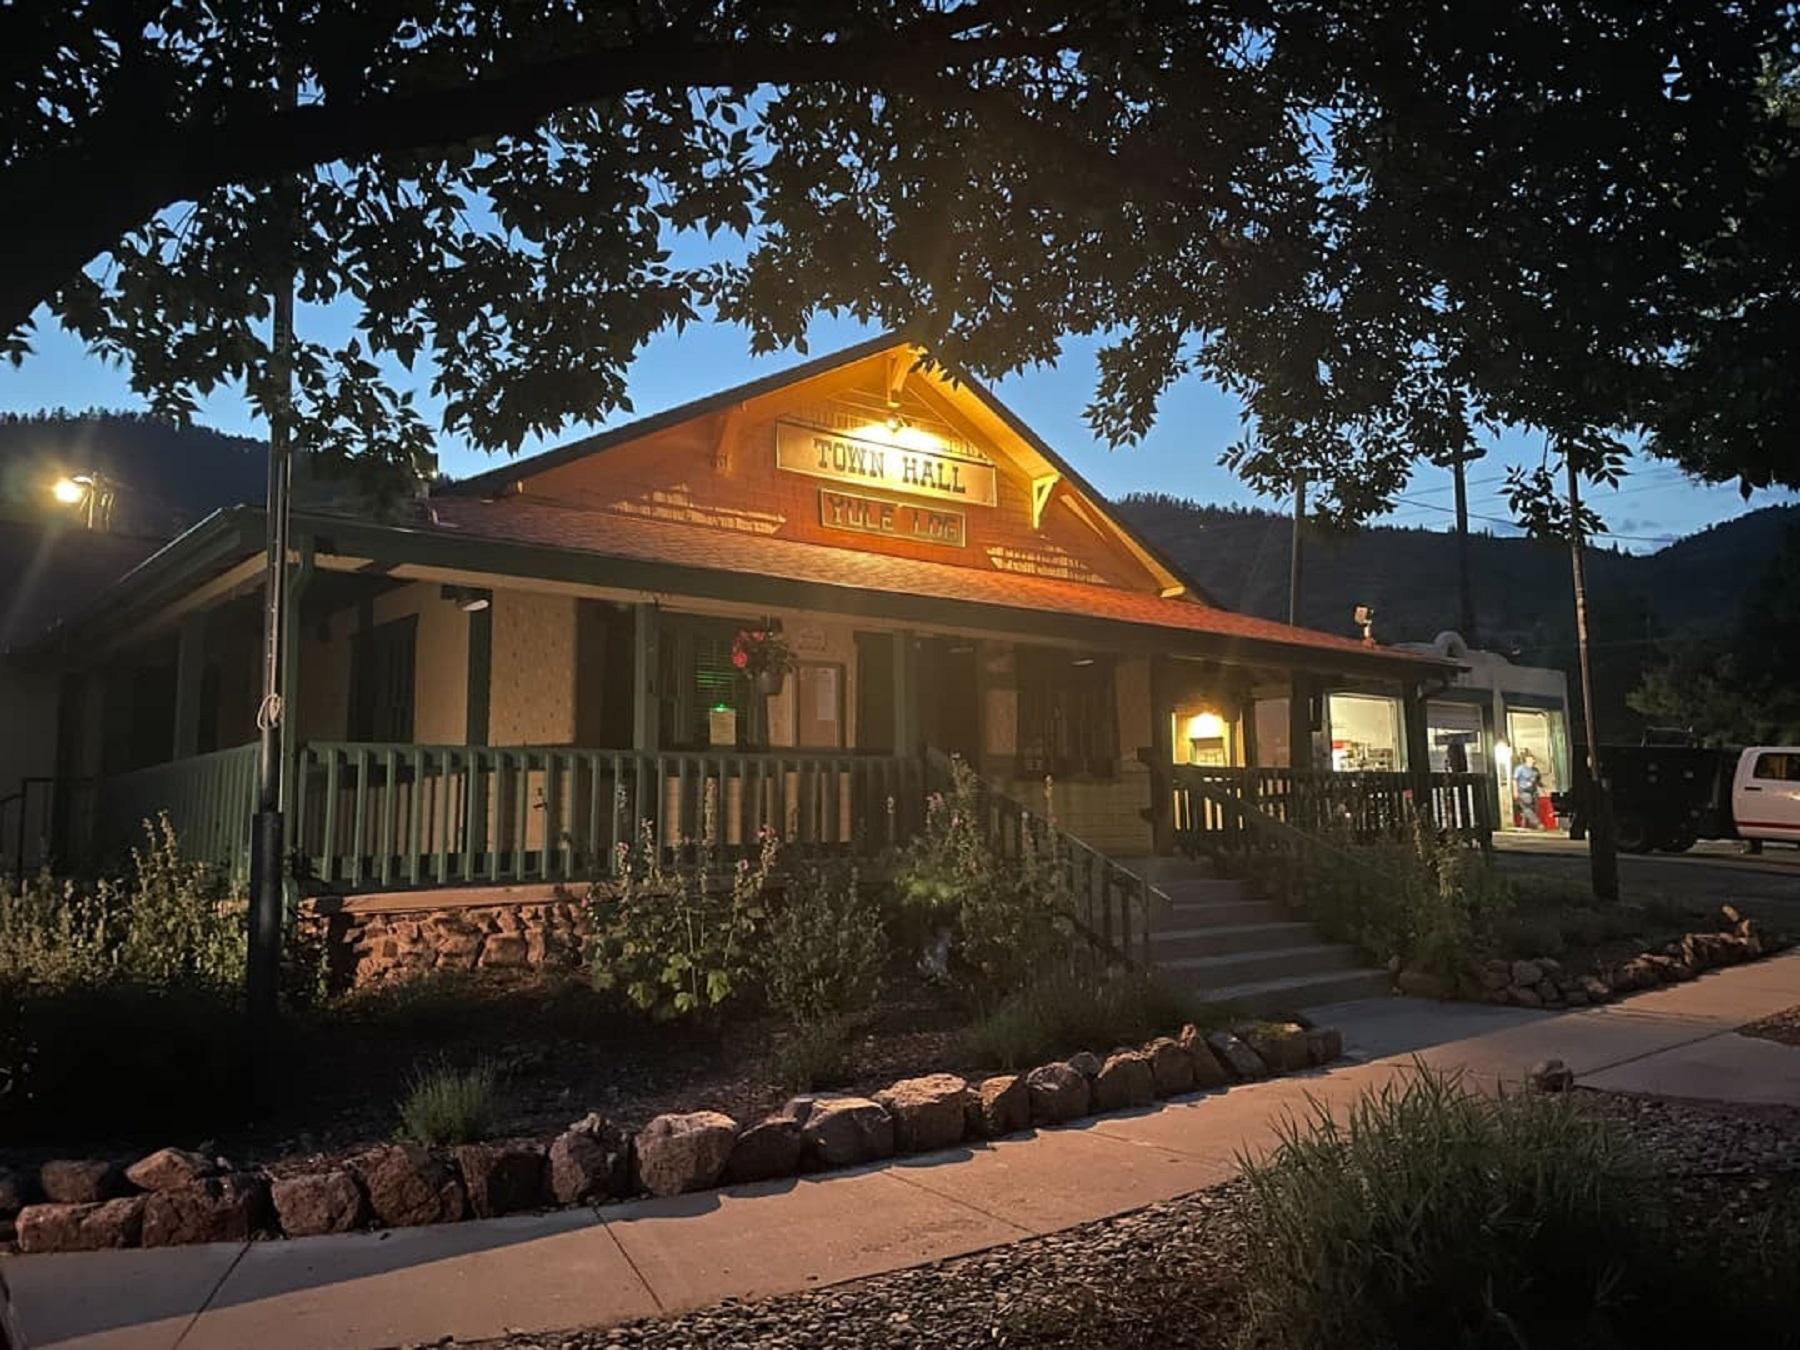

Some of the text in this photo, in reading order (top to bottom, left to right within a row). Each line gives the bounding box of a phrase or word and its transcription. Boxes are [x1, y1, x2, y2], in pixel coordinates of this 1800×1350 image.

[815, 439, 966, 493] TOWN HALL
[829, 496, 958, 541] YULE LOG
